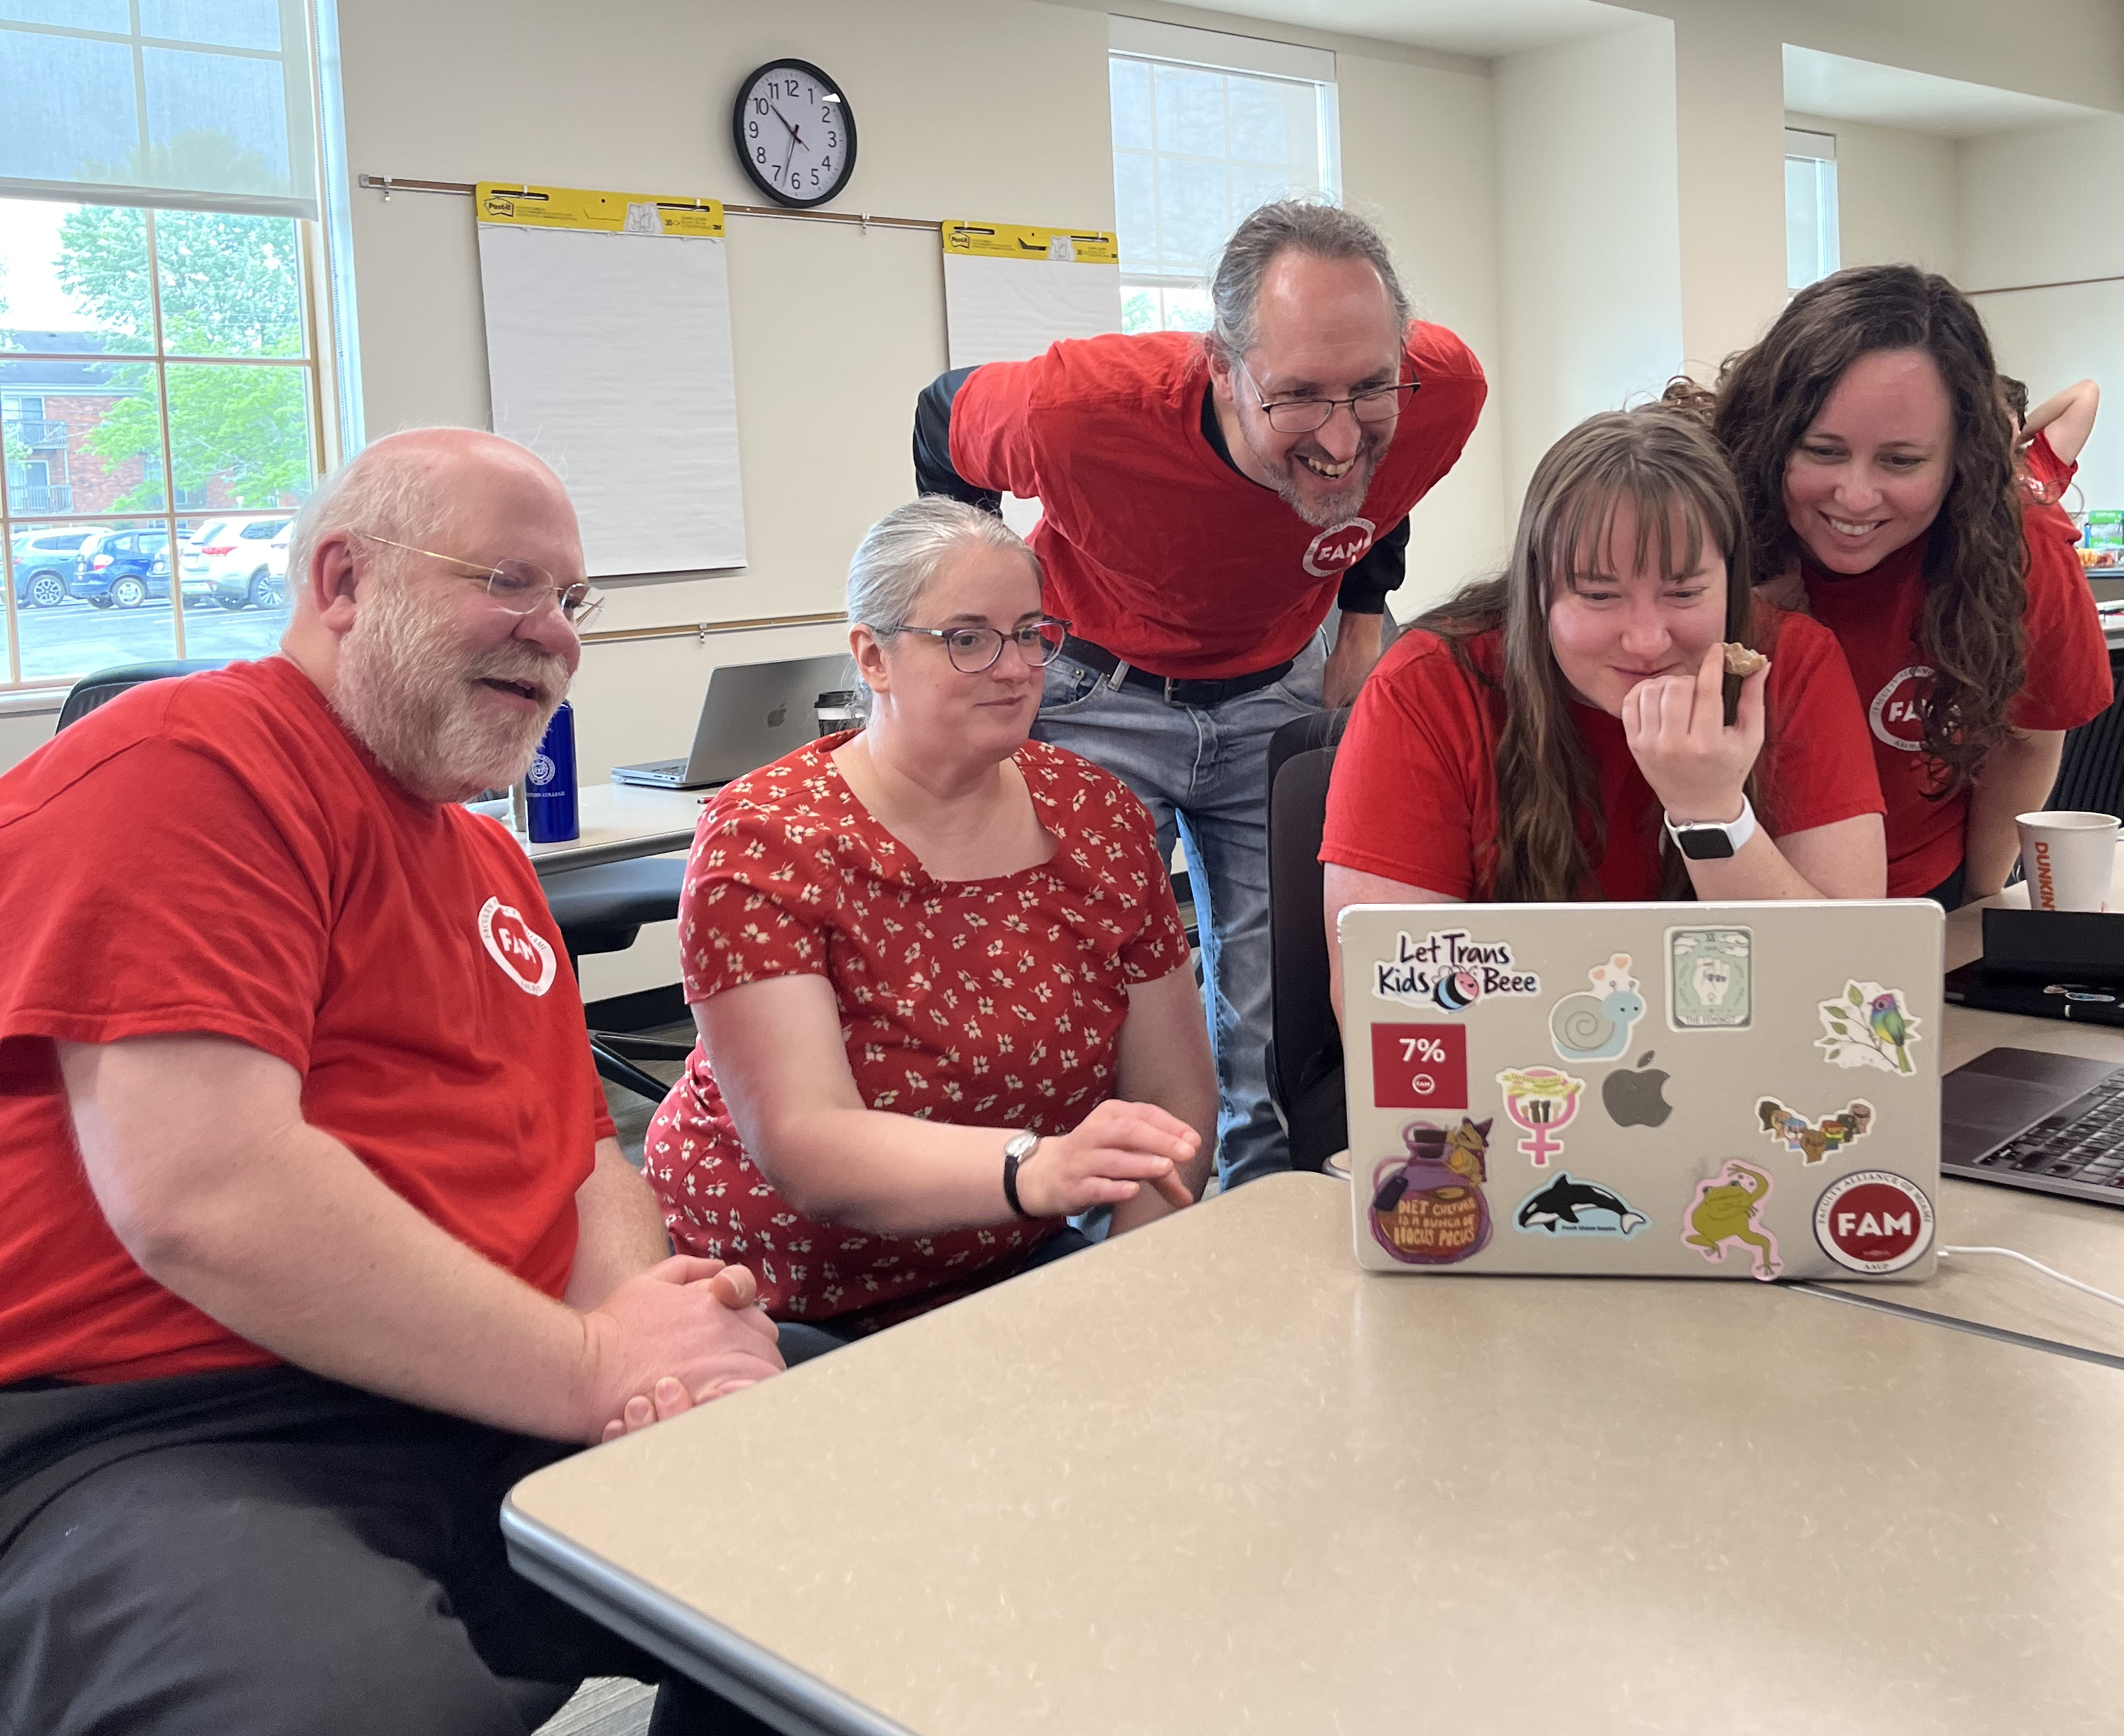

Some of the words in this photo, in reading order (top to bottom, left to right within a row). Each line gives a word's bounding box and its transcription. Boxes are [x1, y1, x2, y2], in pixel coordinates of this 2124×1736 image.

[768, 82, 780, 100] 11
[785, 79, 800, 97] 12
[808, 88, 814, 105] 1
[753, 97, 769, 115] 10
[822, 106, 831, 123] 2
[749, 121, 759, 138] 9
[827, 131, 837, 147] 3
[756, 147, 766, 164] 8
[822, 155, 831, 171] 4
[772, 164, 781, 181] 7
[791, 172, 801, 190] 6
[811, 169, 820, 185] 5
[1317, 538, 1363, 564] FAM
[498, 928, 537, 964] FAM
[1400, 935, 1441, 963] Let
[1441, 933, 1509, 964] Trans
[1377, 965, 1430, 994] Kids
[1481, 966, 1537, 994] Beee
[1686, 1015, 1700, 1024] THE
[1399, 1037, 1446, 1063] 7%
[1398, 1199, 1429, 1214] DIET
[1433, 1197, 1476, 1216] CULTURE
[1398, 1215, 1409, 1225] IS
[1412, 1216, 1420, 1225] A
[1423, 1216, 1461, 1228] BUNCH
[1462, 1214, 1475, 1226] OF
[1837, 1211, 1912, 1237] FAM
[1394, 1226, 1434, 1245] HOCUS
[1438, 1226, 1476, 1247] POCUS
